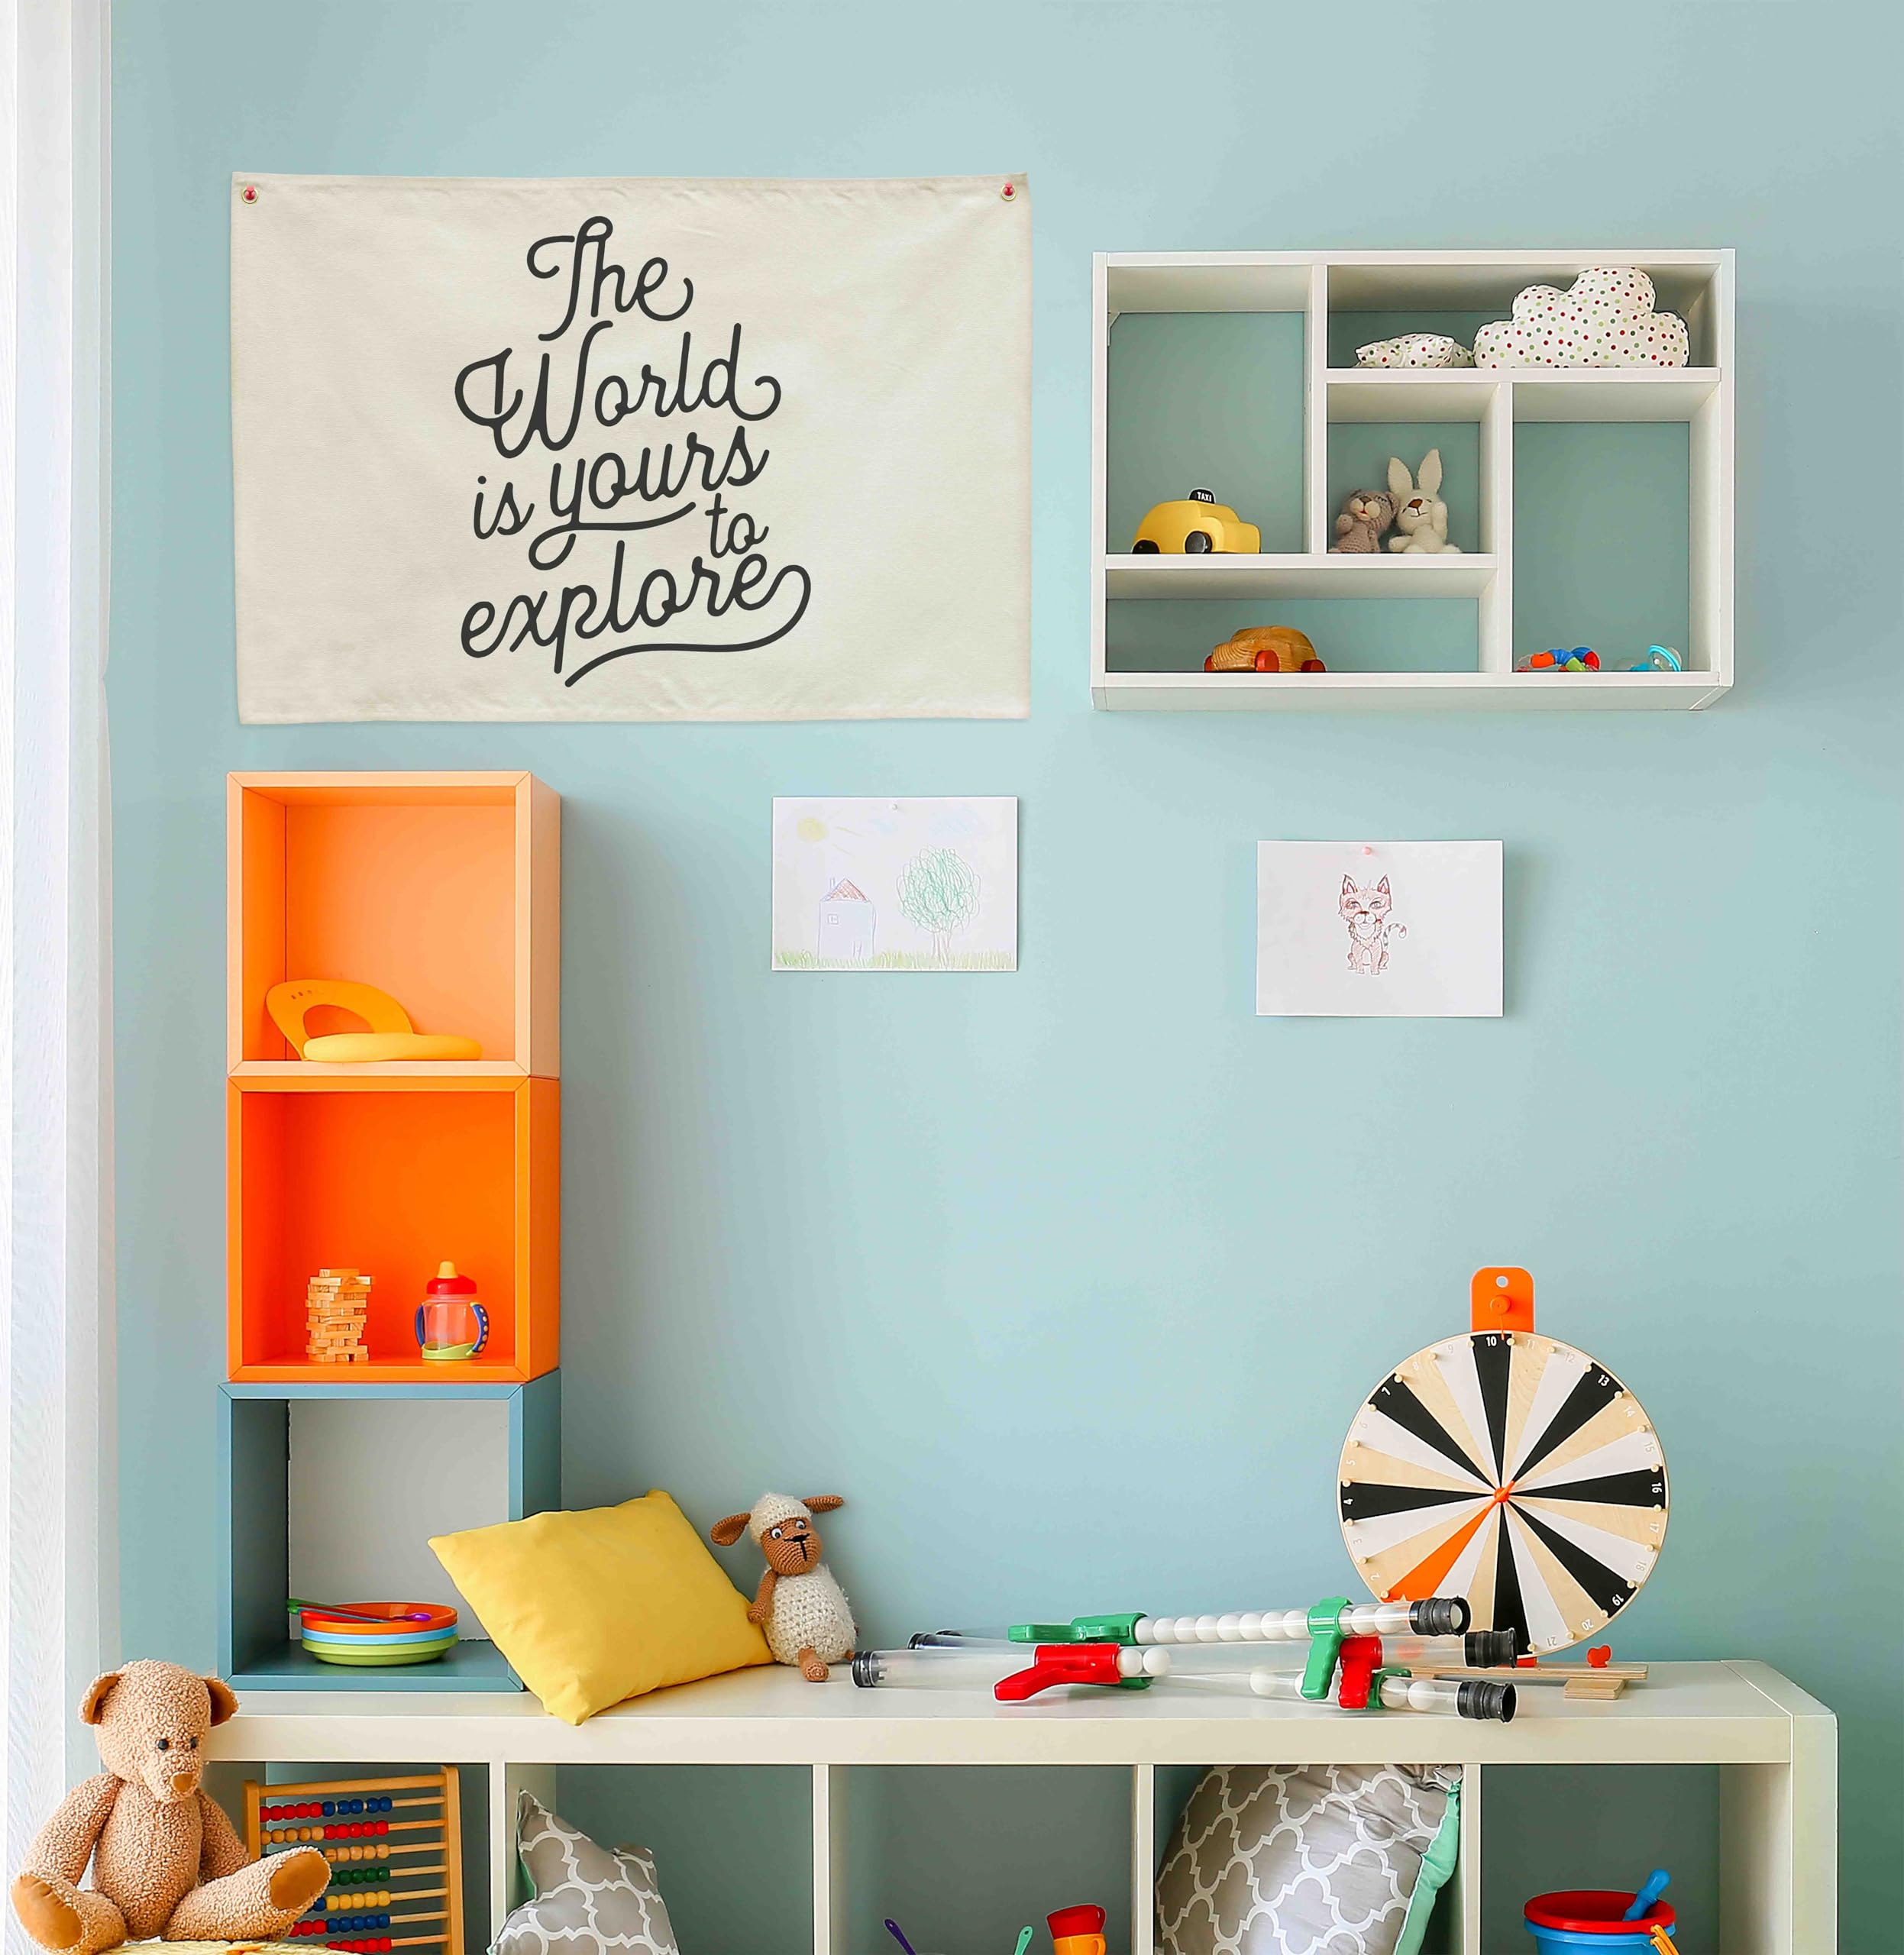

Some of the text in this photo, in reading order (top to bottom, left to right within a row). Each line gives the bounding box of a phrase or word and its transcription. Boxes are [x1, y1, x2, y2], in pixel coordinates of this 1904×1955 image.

[527, 216, 693, 341] The
[455, 321, 781, 458] World
[474, 426, 769, 570] is yours
[1197, 491, 1212, 502] TAXI
[705, 493, 769, 558] to
[461, 541, 810, 687] explore
[1485, 1336, 1497, 1347] 10
[1527, 1339, 1536, 1349] 11
[1447, 1344, 1454, 1354] 9
[1564, 1352, 1575, 1363] 12
[1597, 1374, 1610, 1387] 13
[1381, 1386, 1392, 1396] 7
[1624, 1405, 1636, 1418] 14
[1644, 1442, 1654, 1453] 15
[1650, 1482, 1663, 1494] 16
[1649, 1522, 1660, 1533] 17
[1635, 1560, 1647, 1572] 18
[1370, 1572, 1381, 1582] 2
[1611, 1593, 1624, 1607] 19
[1581, 1618, 1594, 1631] 20
[1547, 1636, 1558, 1647] 21
